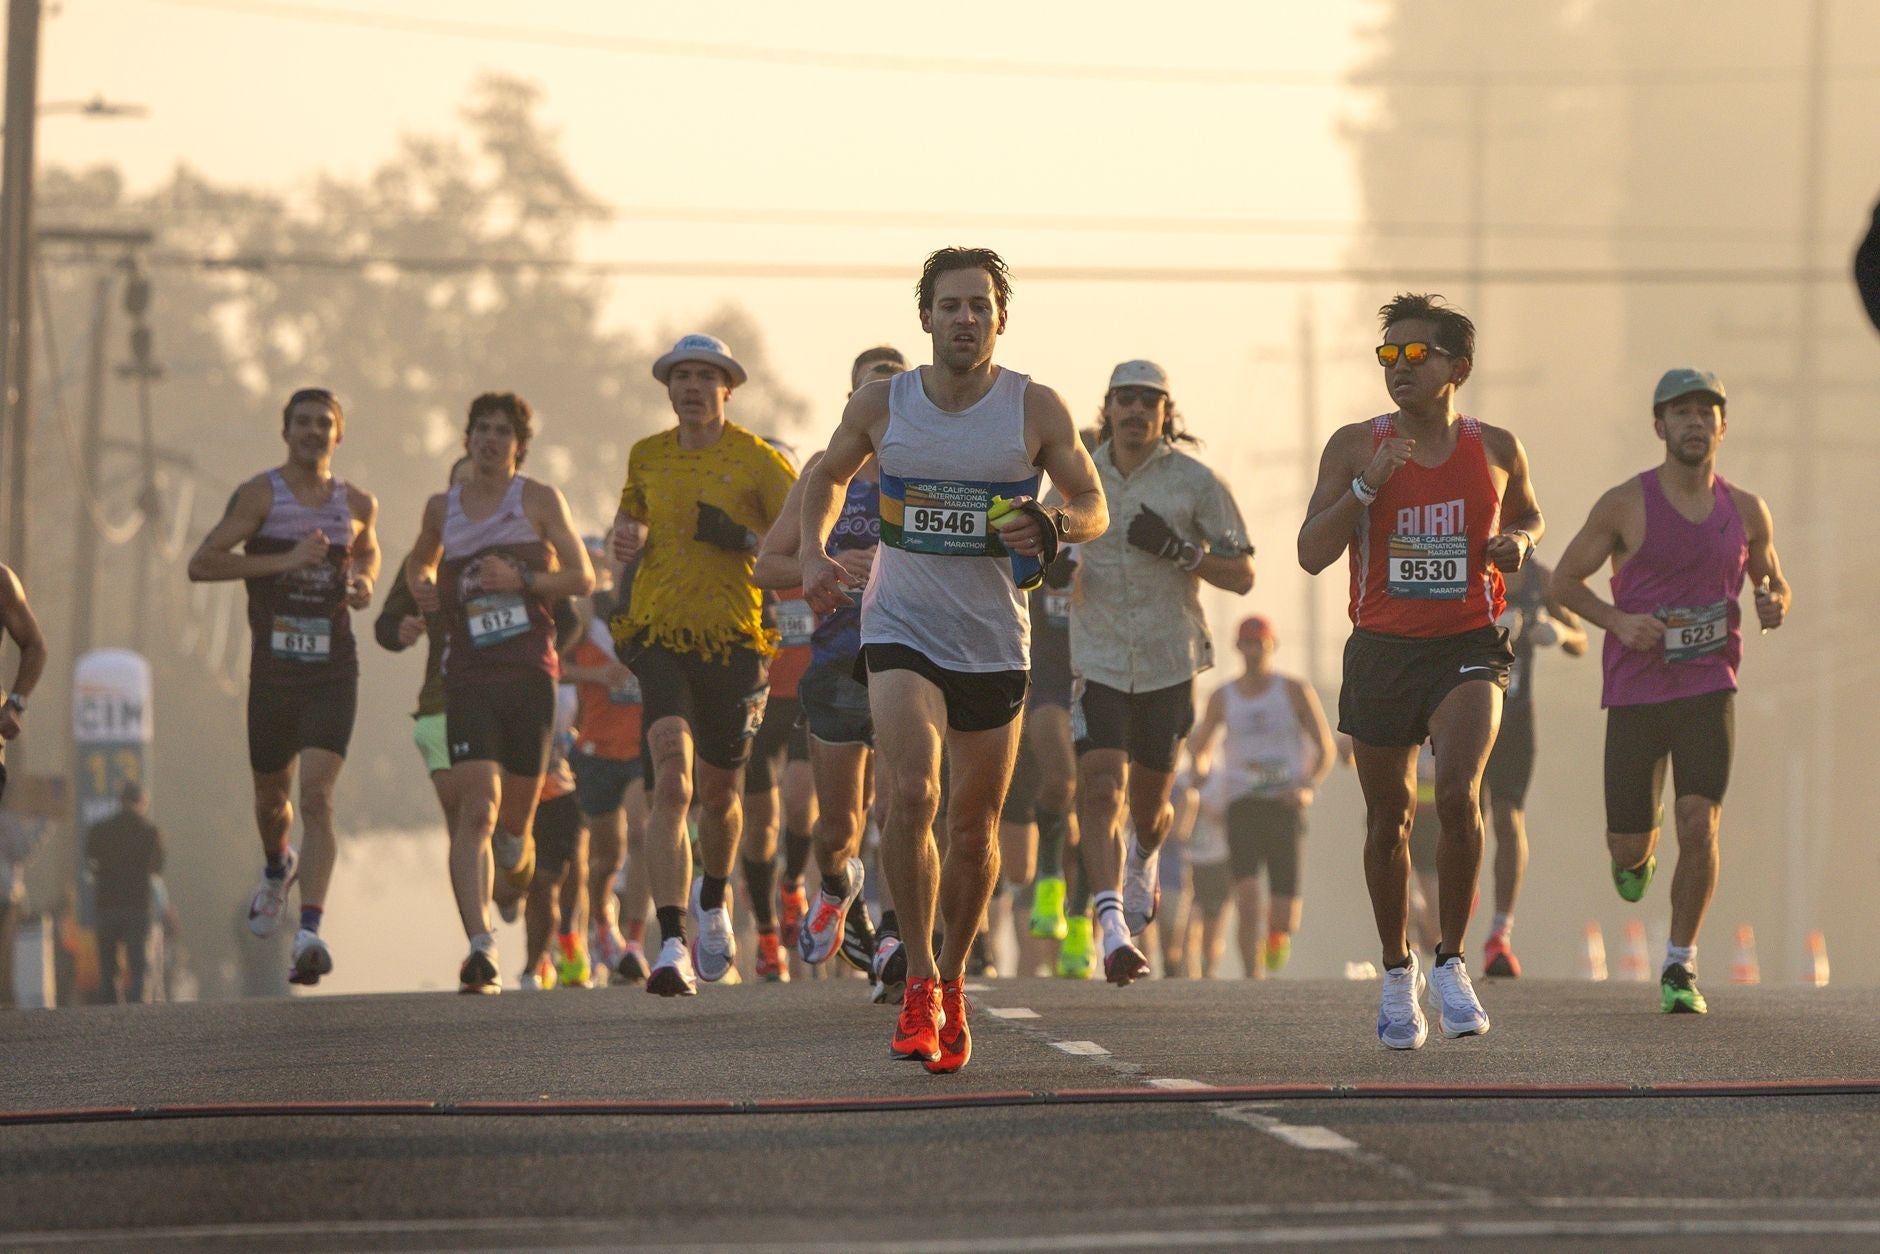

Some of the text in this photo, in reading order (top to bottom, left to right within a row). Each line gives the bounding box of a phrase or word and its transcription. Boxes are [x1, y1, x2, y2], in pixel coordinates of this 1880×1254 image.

[918, 484, 937, 492] 2024
[943, 486, 988, 495] CALIFORNIA
[929, 491, 988, 502] INTERNATIONAL
[944, 500, 988, 509] MARATHON
[914, 509, 975, 535] 9546
[944, 540, 986, 549] MARATHON
[1412, 542, 1467, 550] INTERNATIONAL
[1400, 559, 1457, 581] 9530
[481, 607, 513, 632] 612
[1681, 623, 1715, 646] 623
[285, 635, 317, 652] 613
